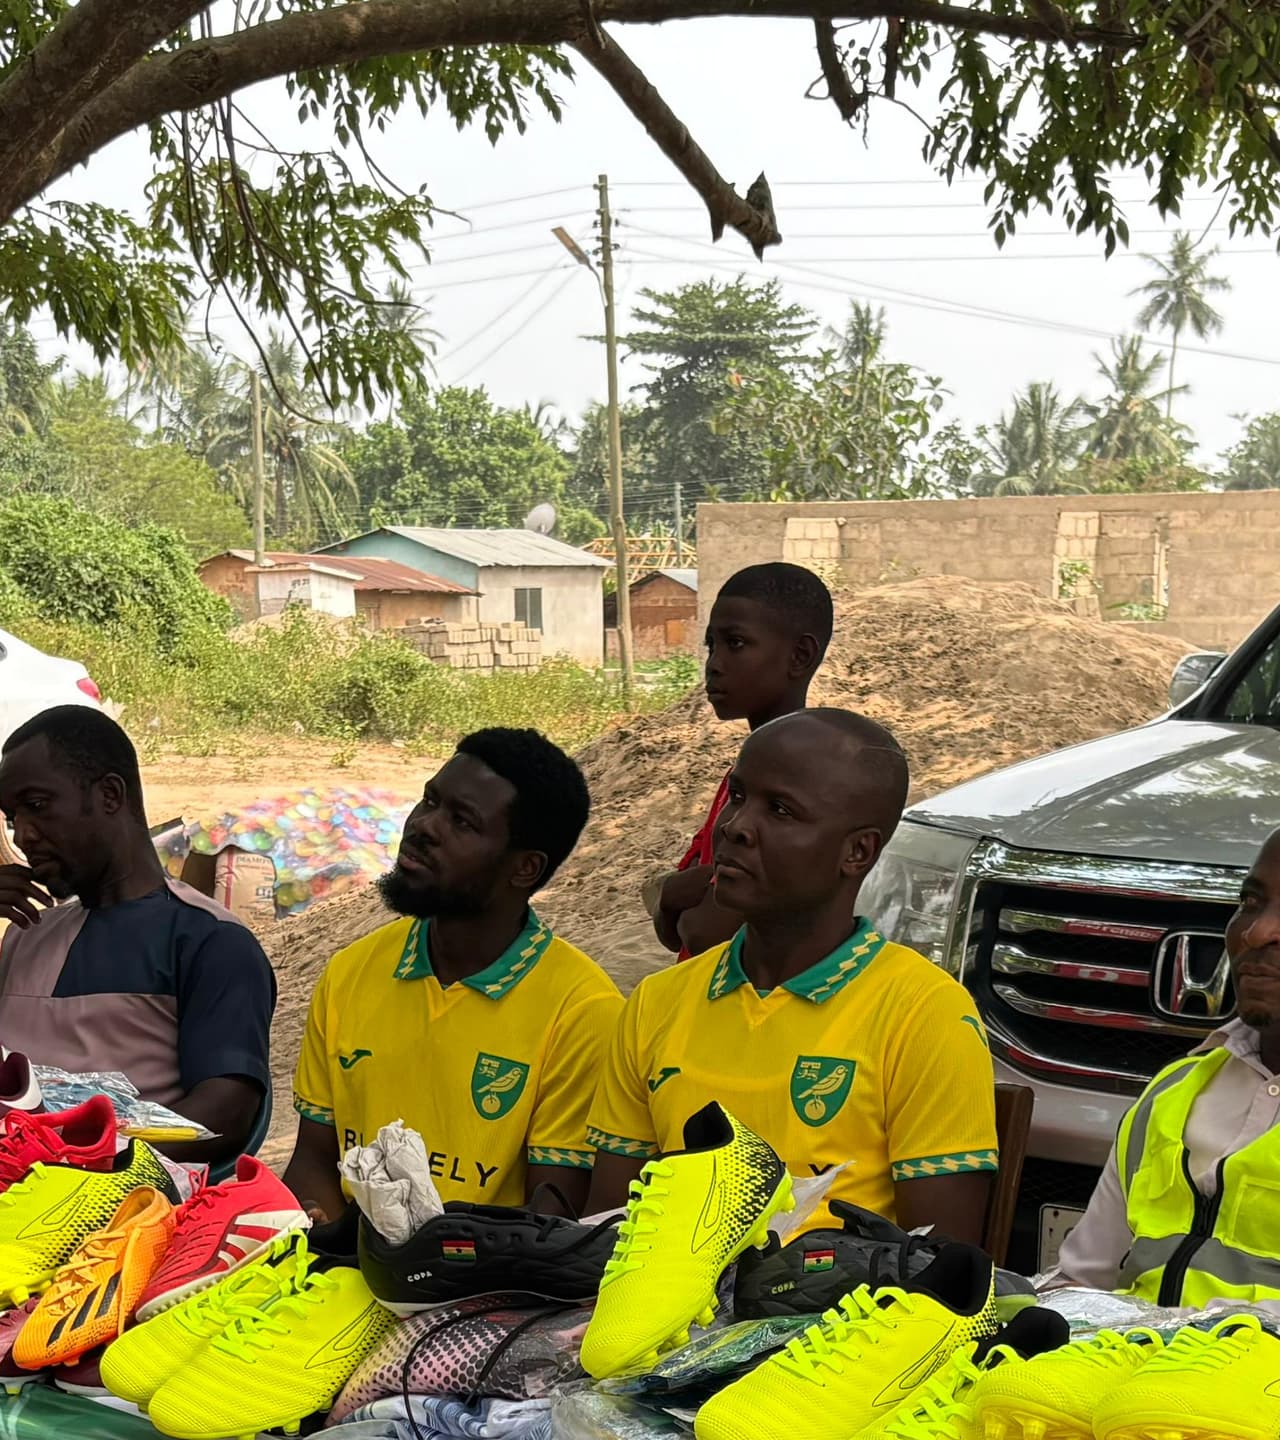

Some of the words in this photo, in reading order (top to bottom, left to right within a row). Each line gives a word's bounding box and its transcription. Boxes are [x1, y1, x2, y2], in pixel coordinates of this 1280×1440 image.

[344, 1128, 498, 1188] BELY
[407, 1270, 433, 1283] COPA
[771, 1280, 796, 1295] COPA
